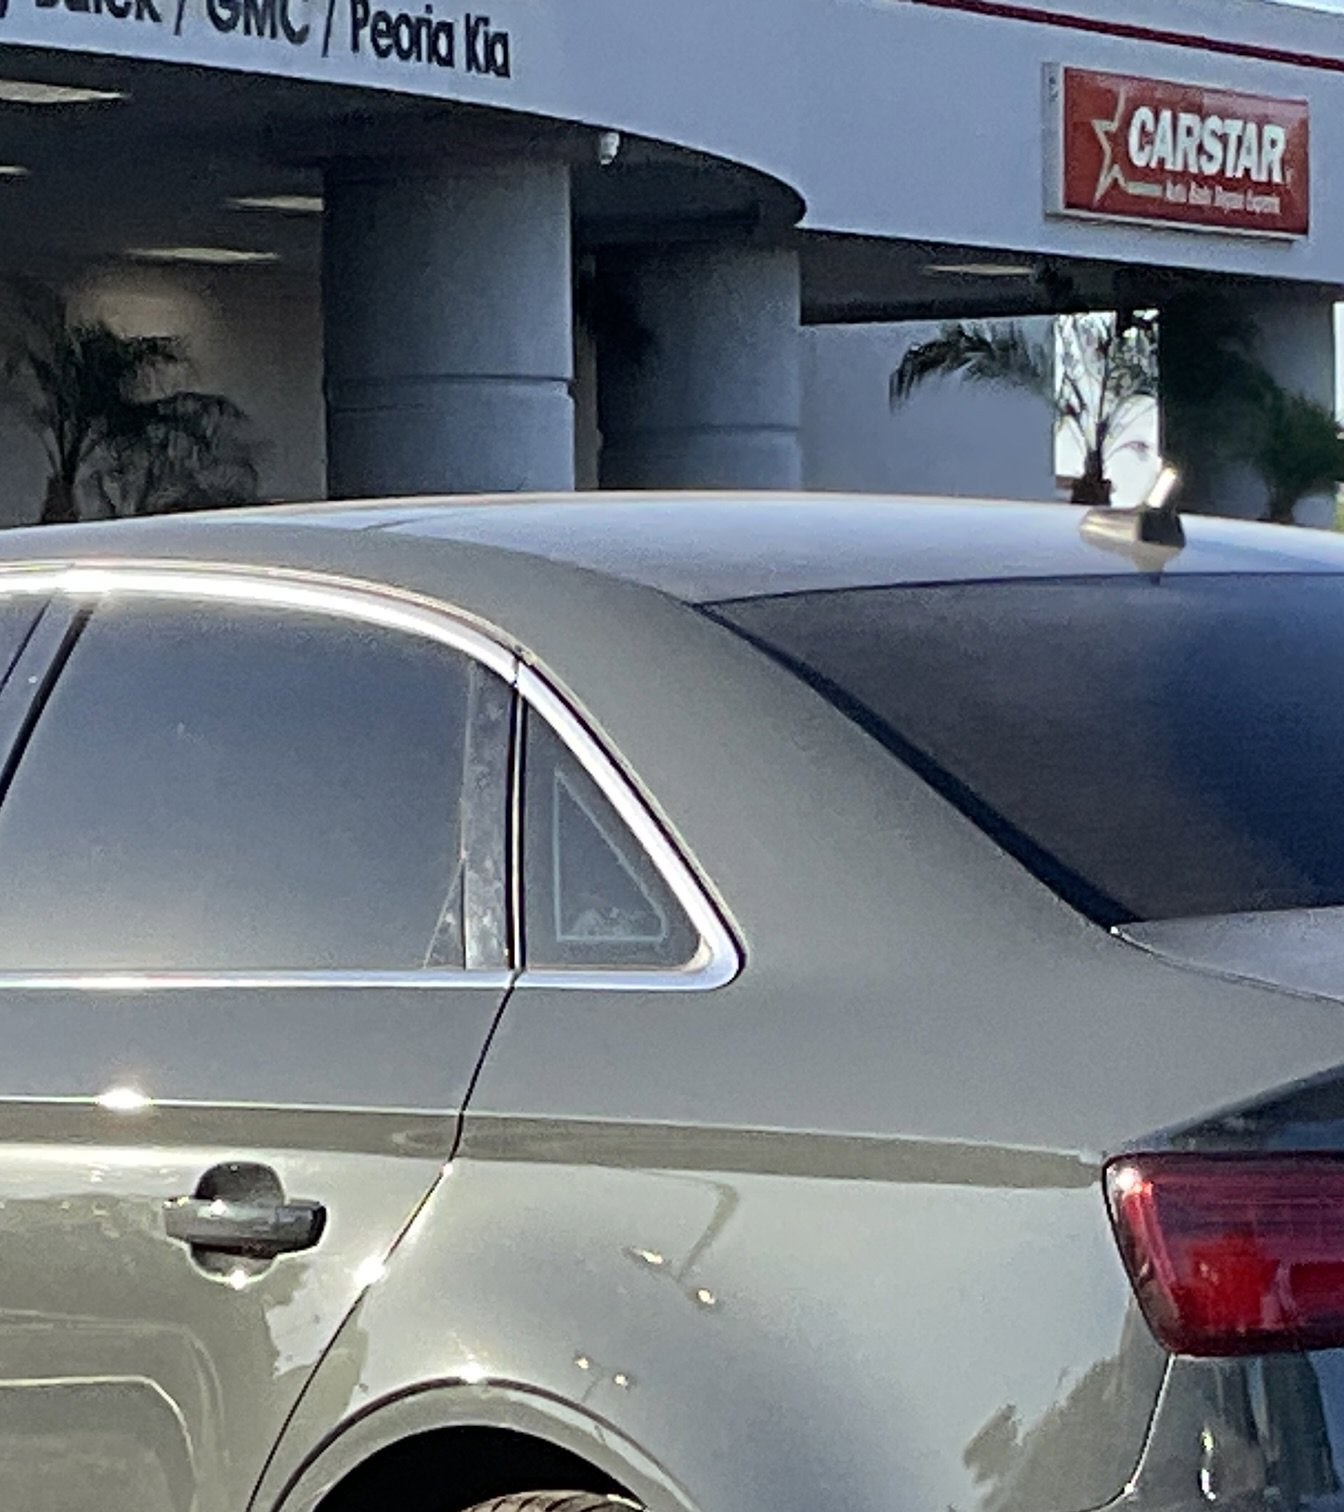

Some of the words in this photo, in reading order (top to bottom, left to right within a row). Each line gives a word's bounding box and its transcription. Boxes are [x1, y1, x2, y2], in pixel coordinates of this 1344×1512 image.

[351, 0, 455, 68] Peoria
[465, 12, 511, 79] Kia
[1128, 106, 1286, 183] CARSTAR
